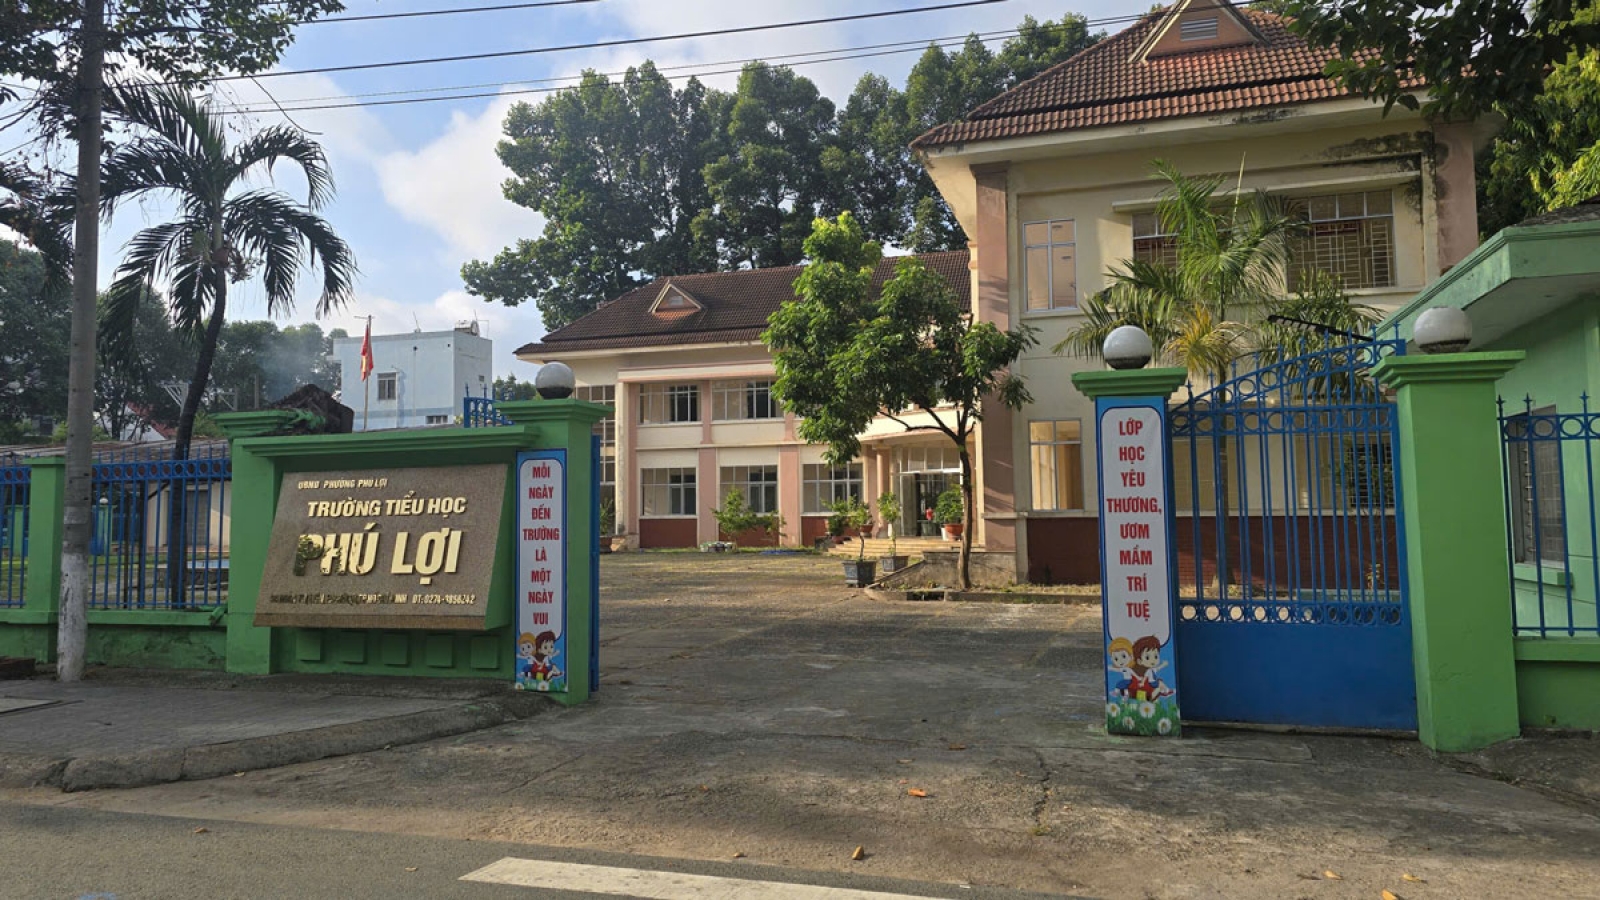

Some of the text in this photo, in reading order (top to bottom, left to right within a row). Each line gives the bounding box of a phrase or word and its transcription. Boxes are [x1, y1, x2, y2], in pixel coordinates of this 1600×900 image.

[1118, 417, 1144, 436] LỚP
[1119, 446, 1145, 465] HỌC
[298, 480, 320, 490] UBND
[323, 477, 356, 489] PHƯỜNG
[1120, 468, 1145, 488] YÊU
[528, 484, 554, 500] NGÀY
[307, 490, 468, 519] TRƯỜNG TIỂU HỌC
[531, 503, 551, 521] ĐẾN
[1106, 496, 1162, 515] THƯƠNG,
[522, 524, 560, 541] TRƯỜNG
[1119, 522, 1150, 540] ƯƠM
[293, 521, 463, 585] PHÚ LỢI
[535, 546, 547, 562] LÀ
[531, 567, 552, 586] MỘT
[1126, 573, 1148, 593] TRÍ
[528, 588, 554, 604] NGÀY
[532, 612, 549, 625] VUI
[1126, 599, 1151, 622] TUỆ
